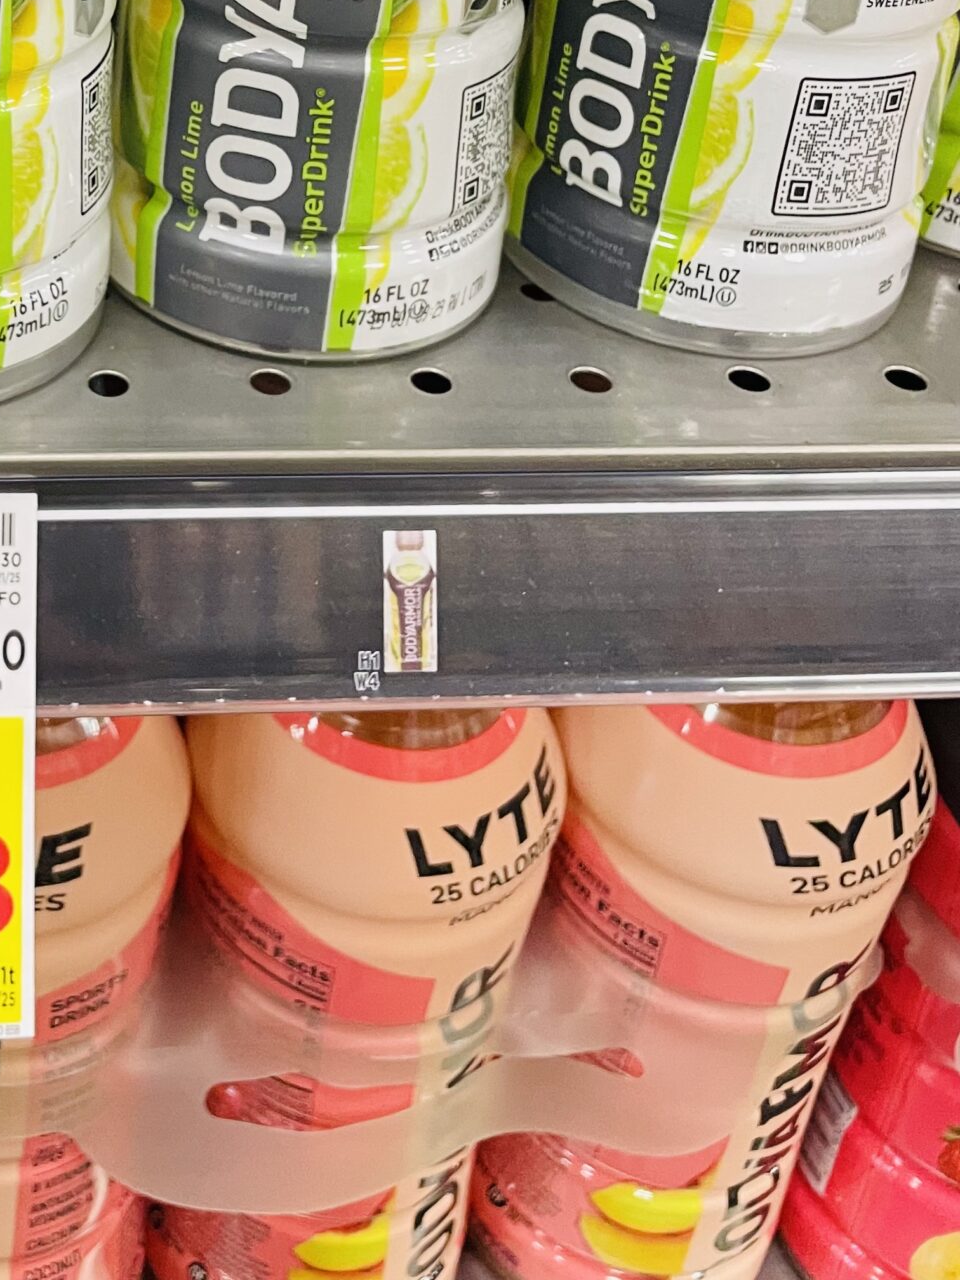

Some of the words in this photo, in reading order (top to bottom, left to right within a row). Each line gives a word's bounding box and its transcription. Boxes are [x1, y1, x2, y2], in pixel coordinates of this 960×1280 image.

[552, 42, 573, 101] Lime
[180, 100, 204, 161] Lime
[544, 105, 563, 176] Lmon
[780, 227, 888, 254] @DRINKBODYARMOR
[652, 273, 715, 304] (473mL)
[677, 259, 692, 277] 16
[695, 263, 714, 282] FL
[719, 267, 741, 285] OZ
[29, 289, 49, 312] FL
[49, 276, 68, 300] OZ
[246, 284, 298, 303] Flavored
[364, 287, 381, 305] 16
[386, 285, 405, 302] FL
[410, 278, 429, 297] OZ
[404, 745, 557, 877] LYTE
[759, 742, 932, 868] LYTE
[34, 822, 93, 888] E
[430, 882, 463, 905] 25
[791, 875, 830, 894] 25
